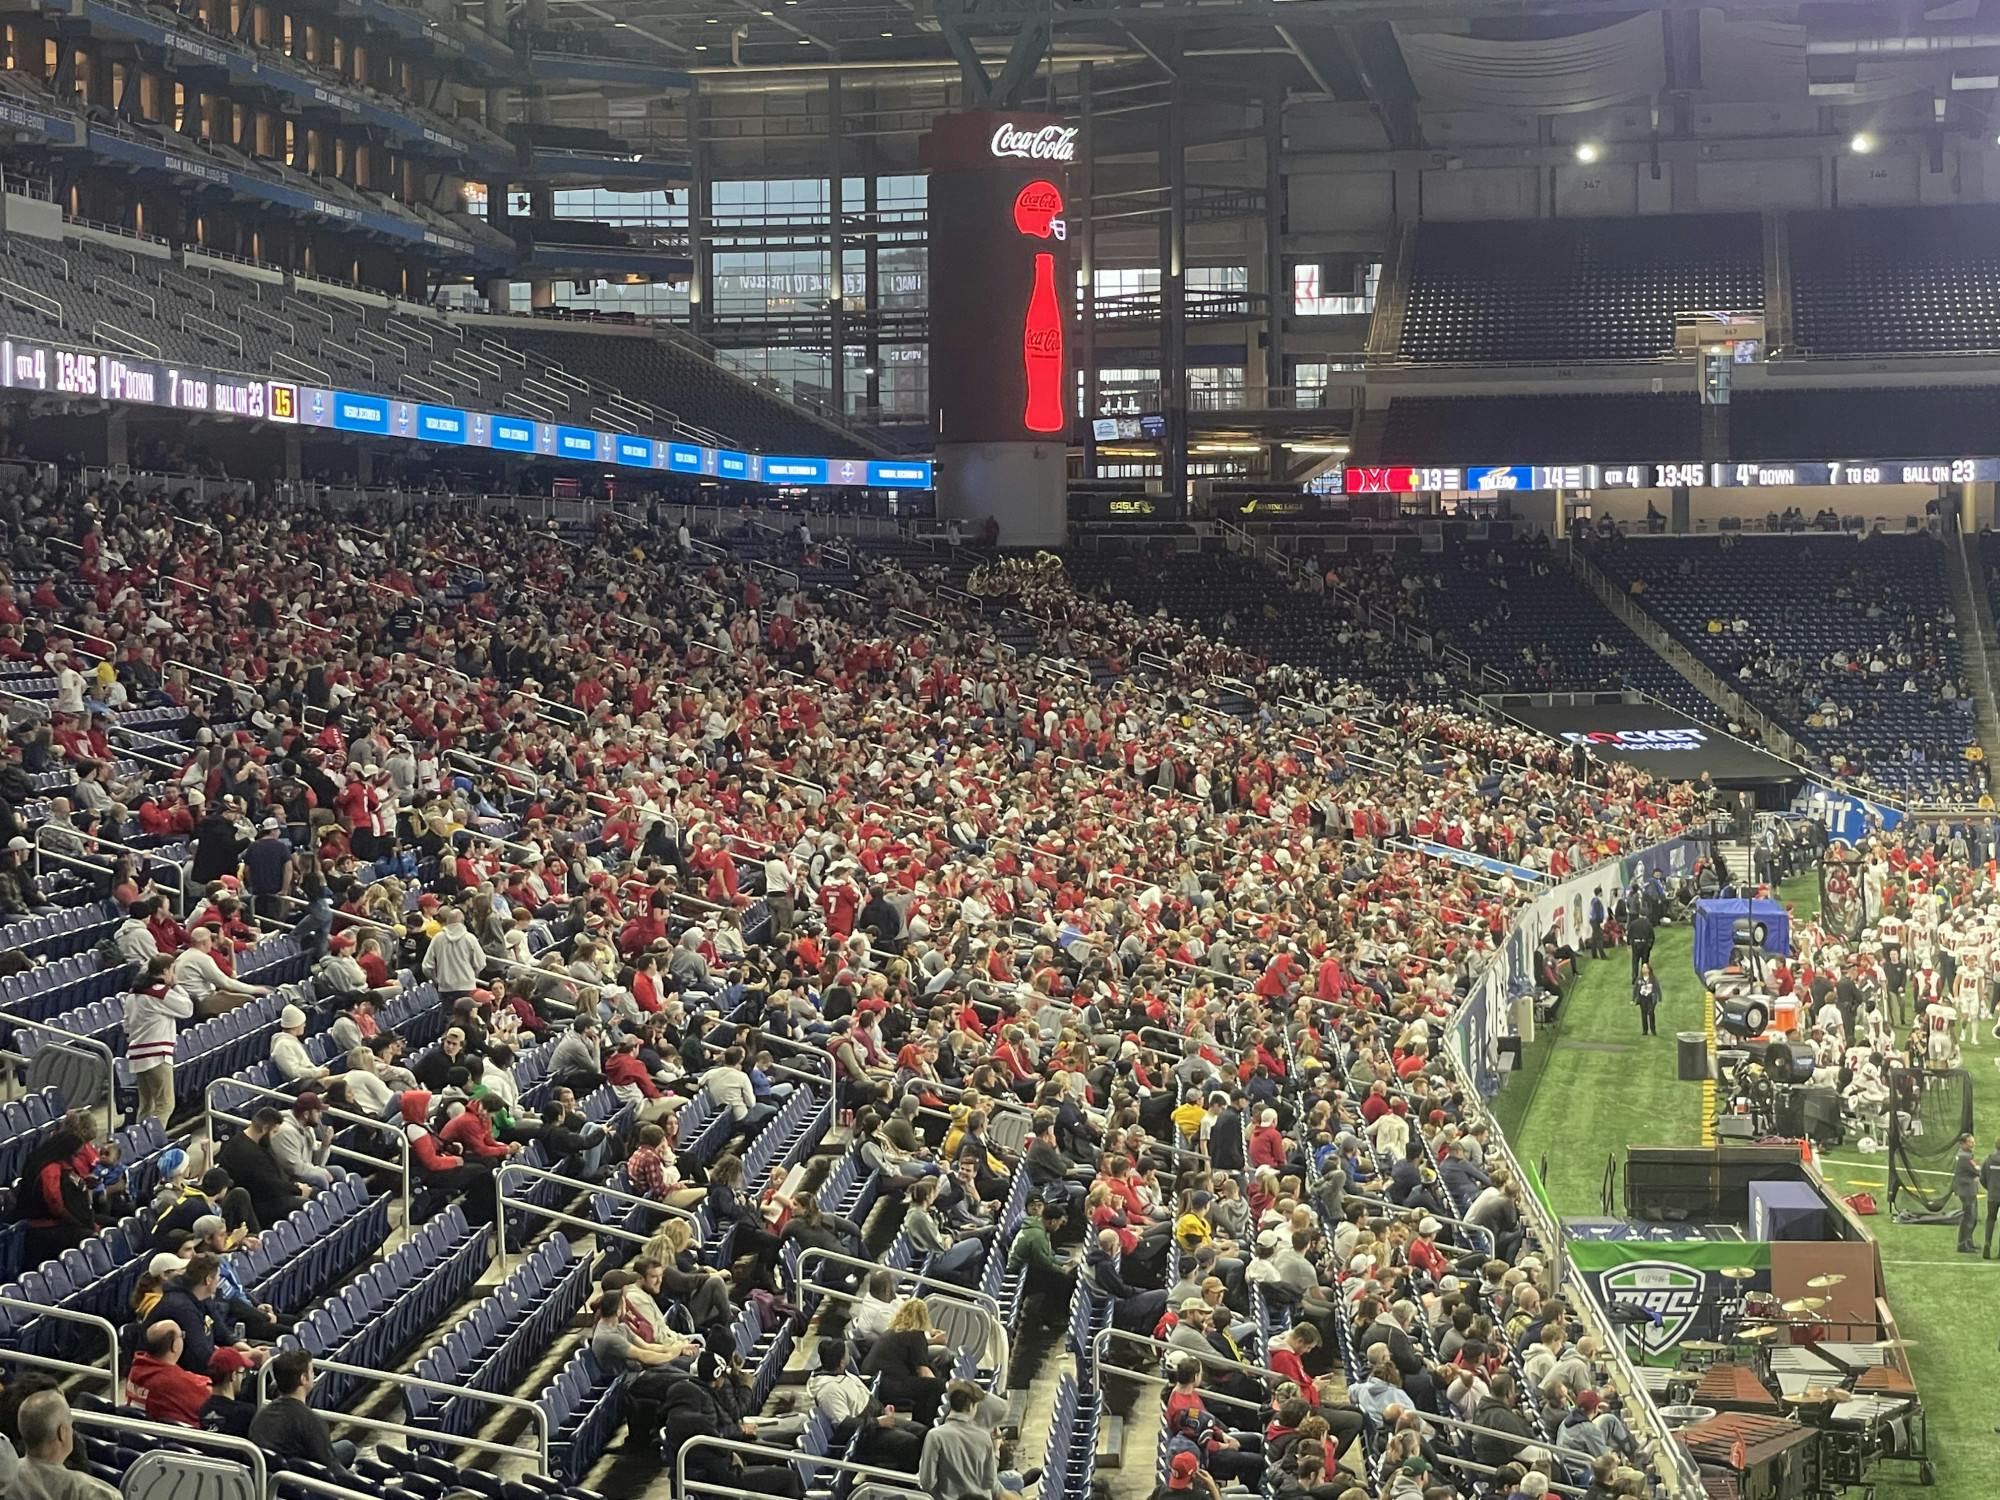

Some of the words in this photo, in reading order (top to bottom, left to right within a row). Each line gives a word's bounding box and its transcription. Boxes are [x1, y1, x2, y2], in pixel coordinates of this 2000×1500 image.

[991, 122, 1079, 160] Coca-Cola
[17, 355, 33, 380] QTR
[35, 349, 46, 389] 4
[56, 351, 97, 394] 13:45
[126, 370, 154, 402] DOWN
[168, 369, 178, 406] 7
[181, 379, 193, 406] TO
[195, 381, 207, 409] GO
[215, 383, 235, 412] BALL
[235, 386, 247, 413] ON
[248, 381, 264, 417] 23
[275, 388, 291, 417] 15
[1422, 468, 1442, 490] 13
[1478, 475, 1517, 491] TOLEDO
[1543, 467, 1563, 489] 14
[1605, 470, 1622, 485] QTR
[1626, 465, 1639, 488] 4
[1656, 464, 1704, 487] 13:45
[1759, 469, 1794, 485] DOWN
[1828, 462, 1840, 484] 7
[1846, 468, 1861, 483] TO
[1863, 468, 1880, 483] GO
[1903, 467, 1932, 483] BALL
[1932, 466, 1949, 482] ON
[1952, 459, 1975, 483] 23
[1110, 501, 1141, 510] EAGLE
[1612, 742, 1701, 751] Mortgage
[828, 896, 837, 914] 7
[1980, 932, 1993, 944] 73
[1931, 1015, 1945, 1031] 10
[1850, 1055, 1858, 1072] 2
